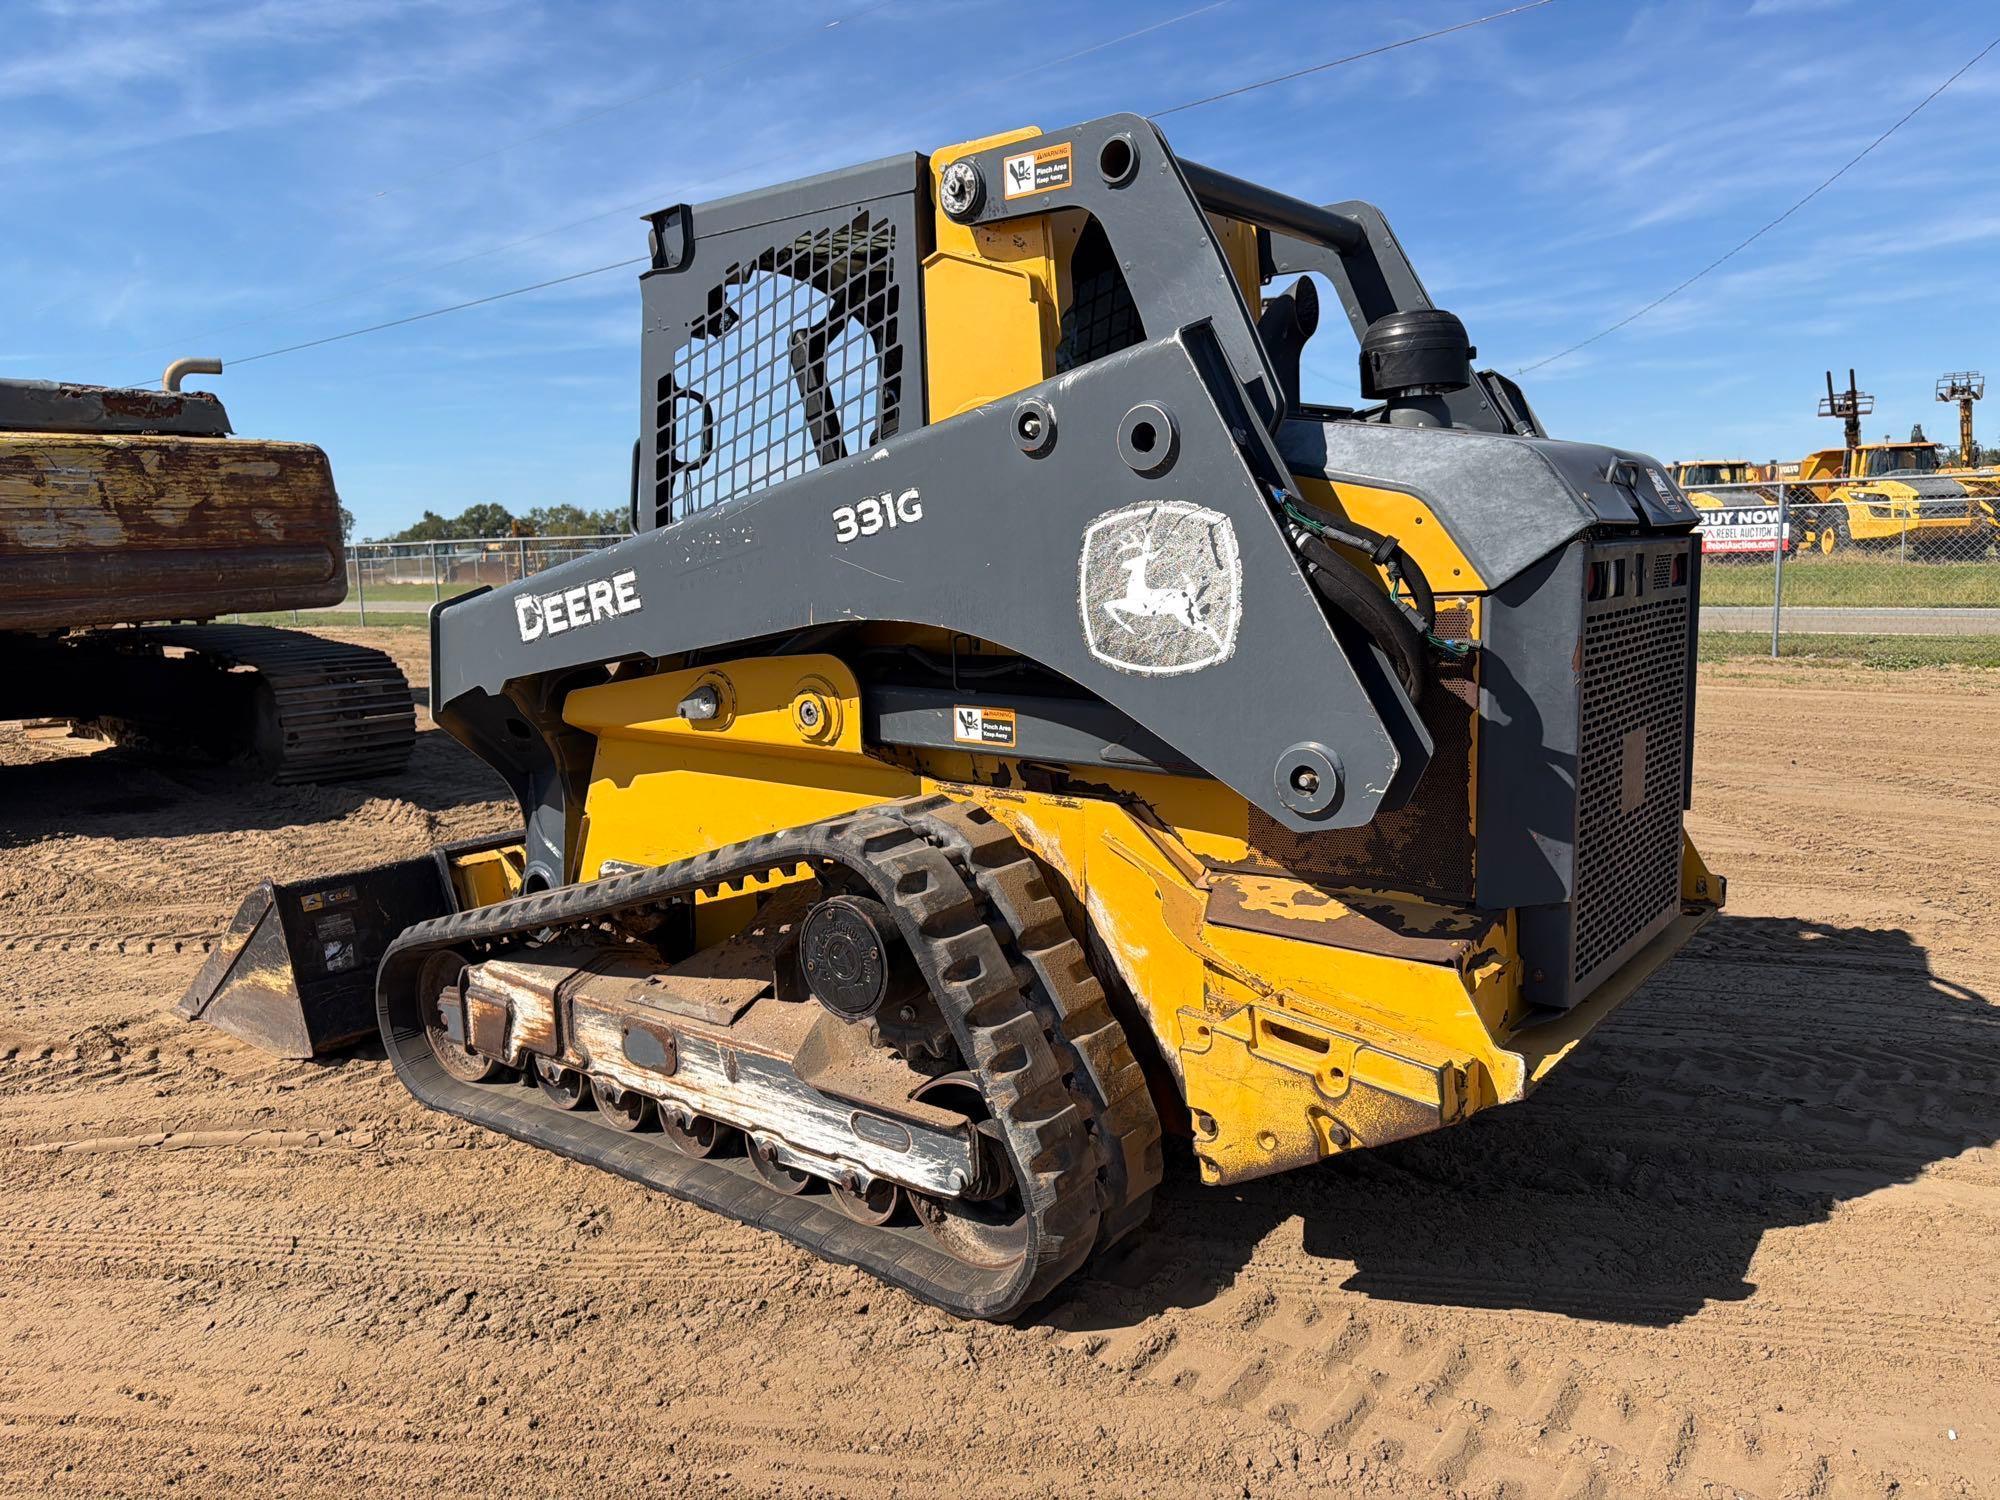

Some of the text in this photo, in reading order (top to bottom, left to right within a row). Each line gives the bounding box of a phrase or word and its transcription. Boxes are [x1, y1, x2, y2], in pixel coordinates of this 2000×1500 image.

[1041, 148, 1067, 158] WARNING
[1037, 163, 1067, 176] Pinch Area
[832, 489, 923, 543] 331G
[1698, 510, 1779, 526] BUY NOW
[1716, 528, 1737, 539] REBEL
[1740, 527, 1774, 538] AUCTION
[1706, 541, 1775, 550] RebelAuction.com
[514, 570, 642, 642] DEERE
